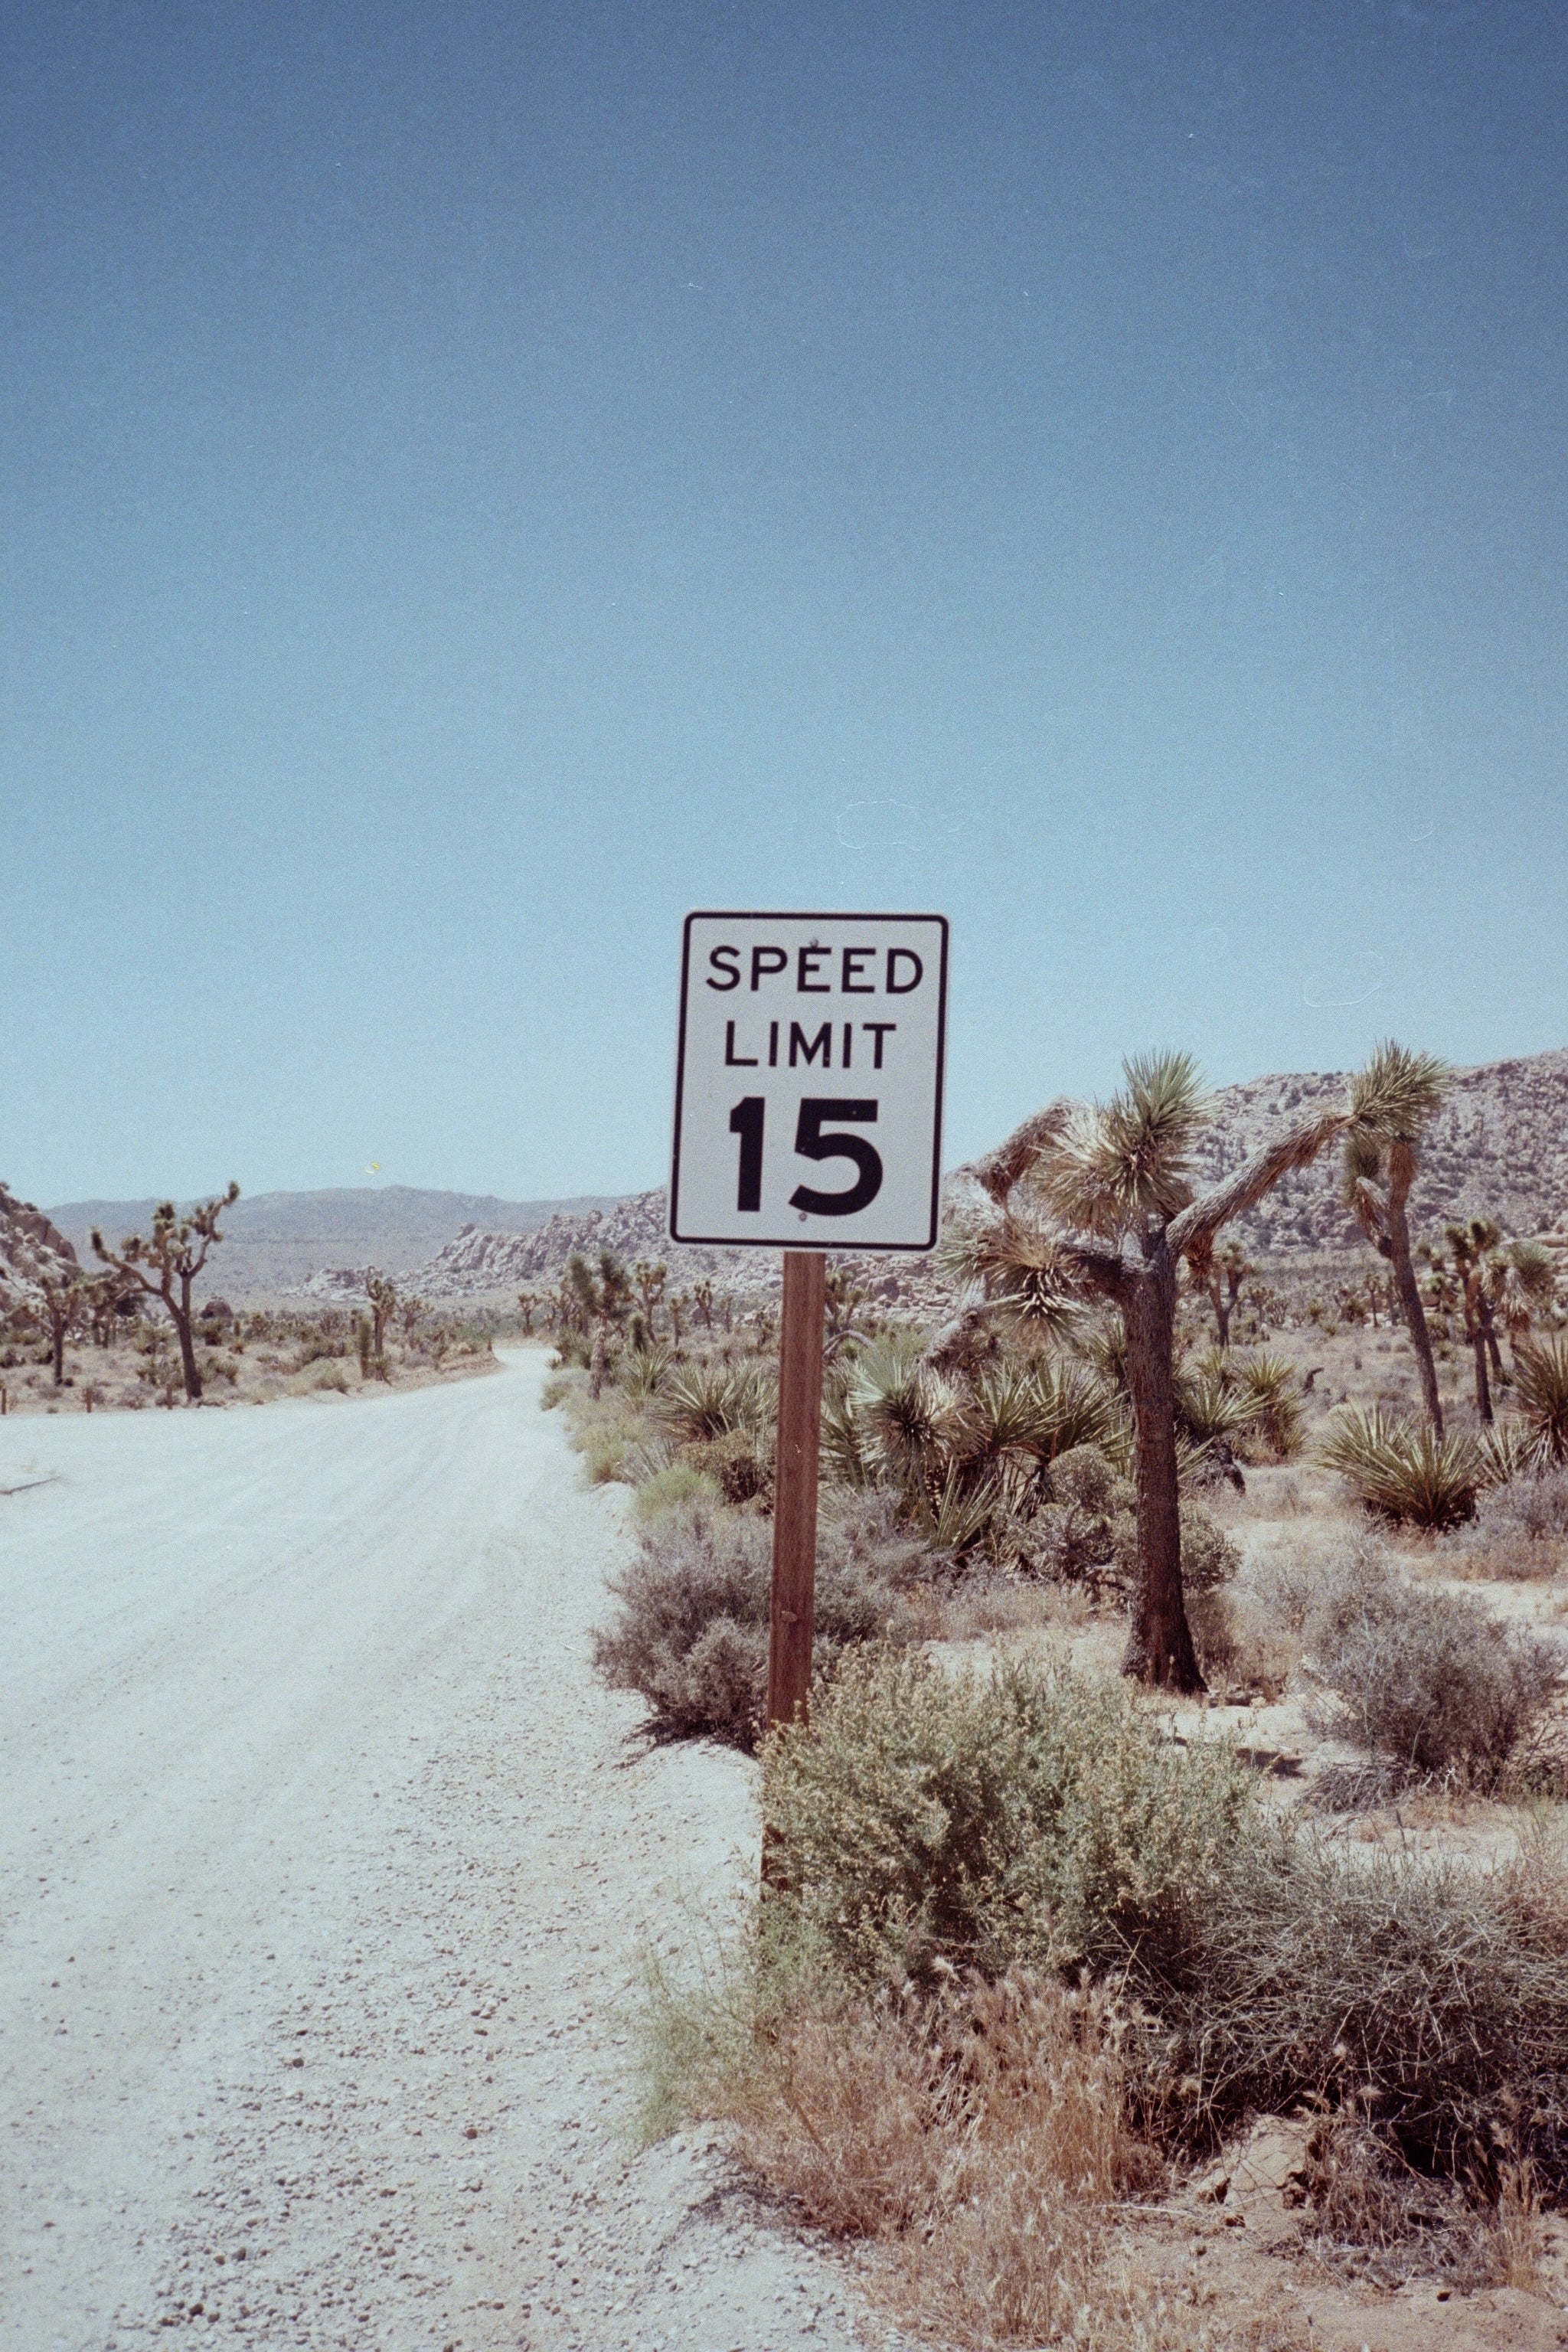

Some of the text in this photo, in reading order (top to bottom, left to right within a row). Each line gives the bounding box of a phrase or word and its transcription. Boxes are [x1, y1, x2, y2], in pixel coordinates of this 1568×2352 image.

[705, 945, 923, 995] SPEED
[724, 1020, 897, 1070] LIMIT
[729, 1096, 884, 1217] 15
